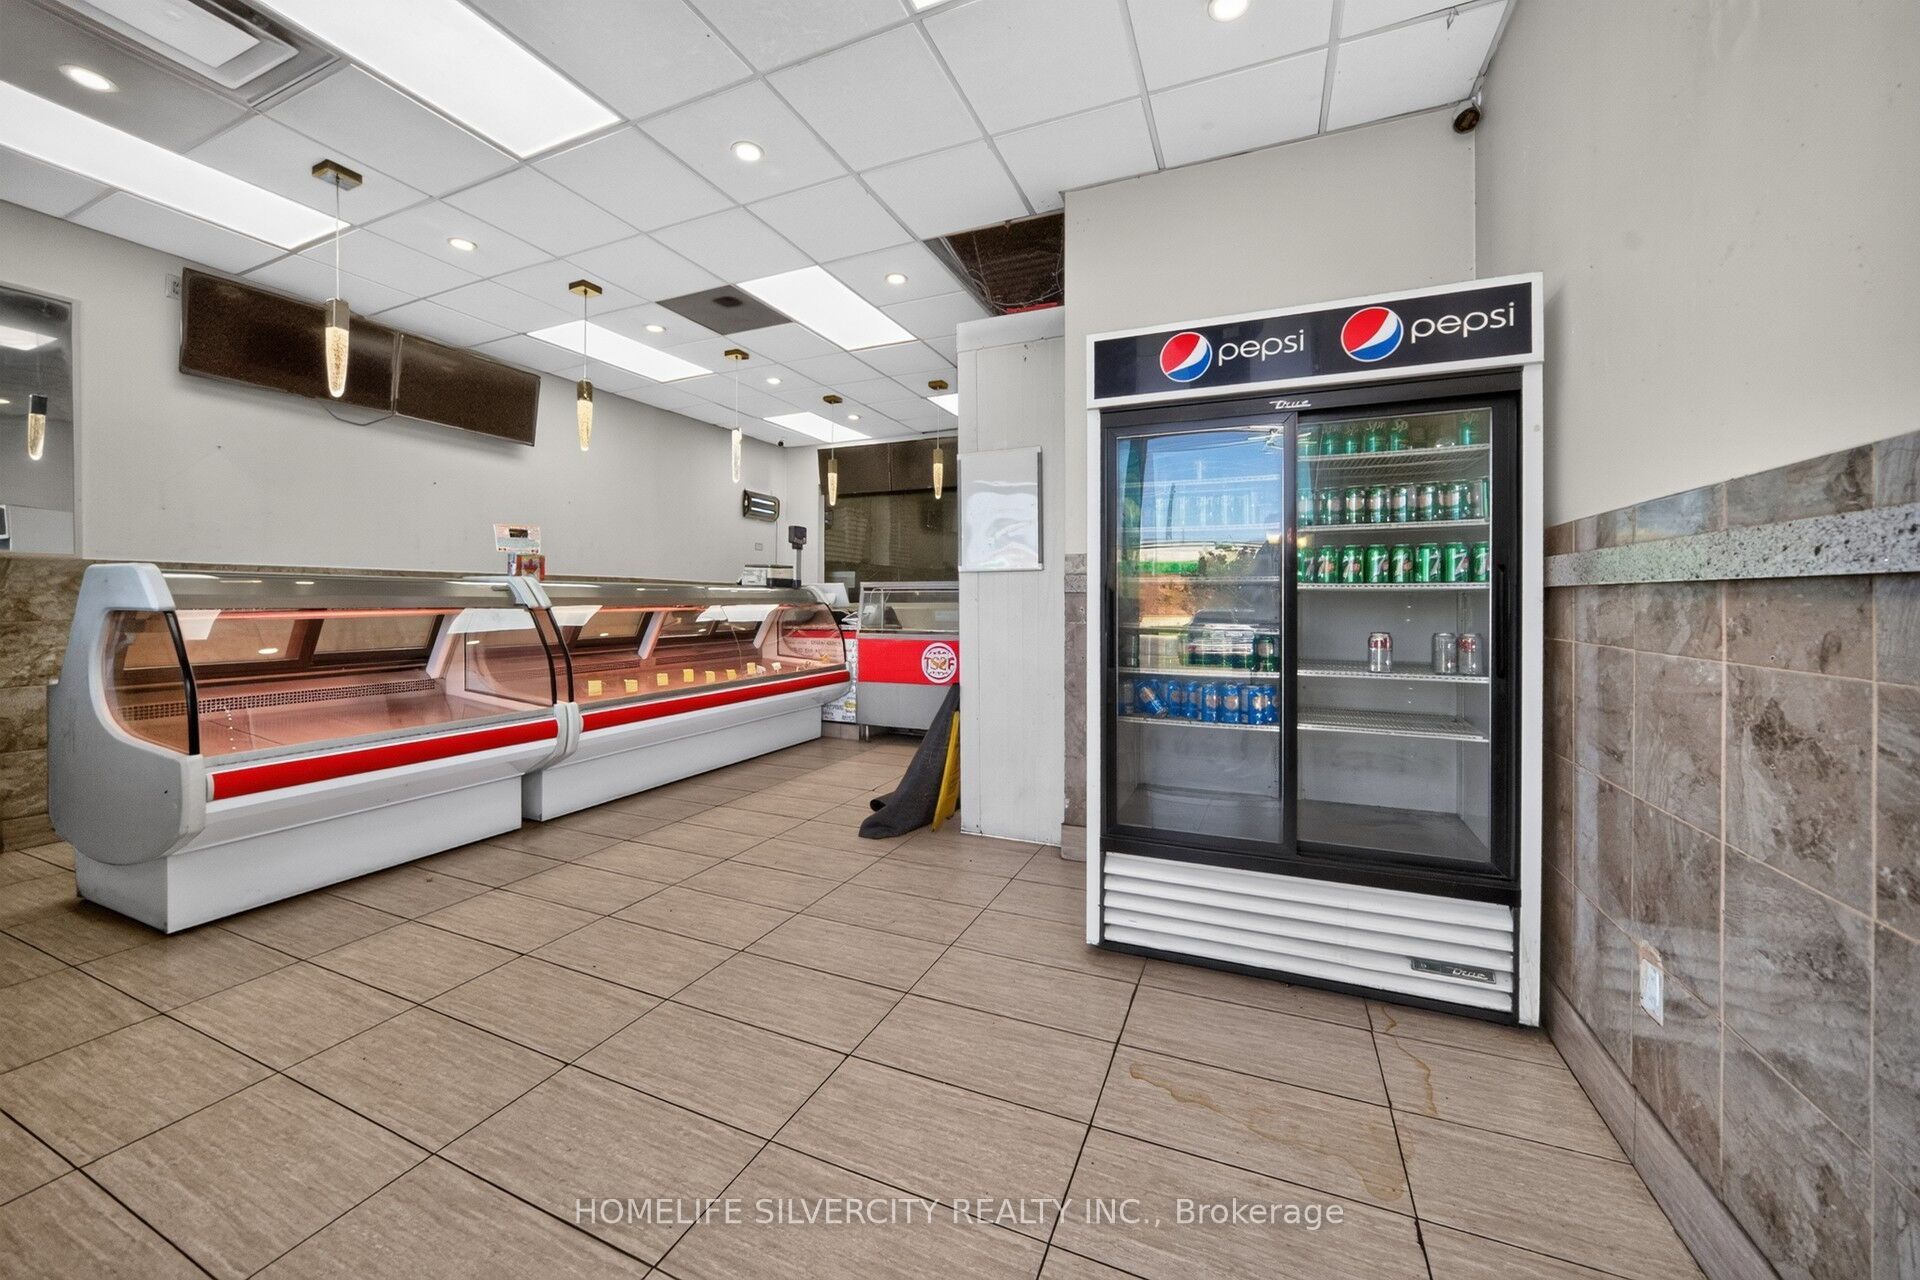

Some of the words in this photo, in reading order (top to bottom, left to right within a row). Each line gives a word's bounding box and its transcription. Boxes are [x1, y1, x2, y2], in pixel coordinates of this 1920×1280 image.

[1411, 301, 1515, 344] pepsi
[1218, 328, 1305, 367] pepsi
[1269, 399, 1312, 409] True
